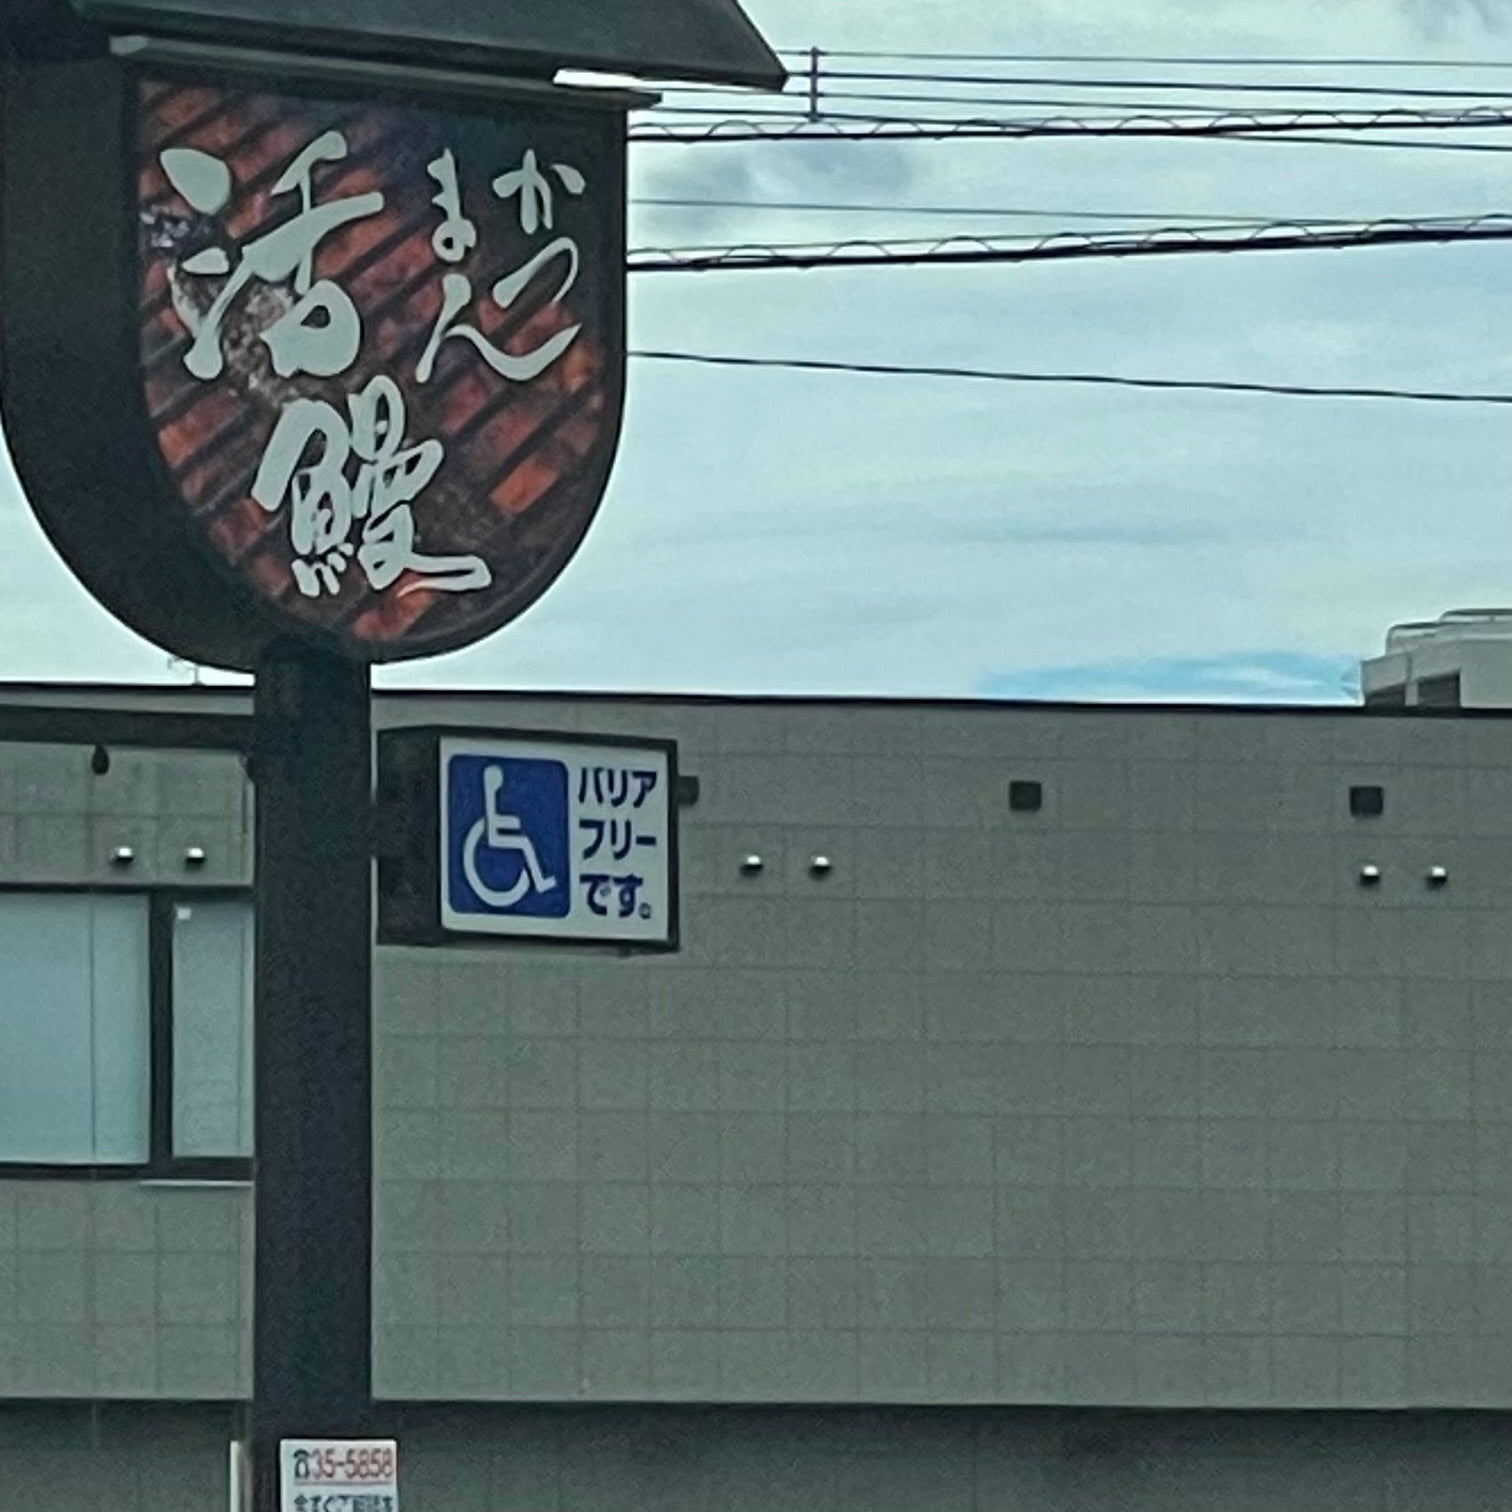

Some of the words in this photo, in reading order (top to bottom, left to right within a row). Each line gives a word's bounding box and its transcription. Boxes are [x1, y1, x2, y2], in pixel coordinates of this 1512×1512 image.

[160, 130, 491, 597] 活鰻
[578, 819, 657, 860] フリー
